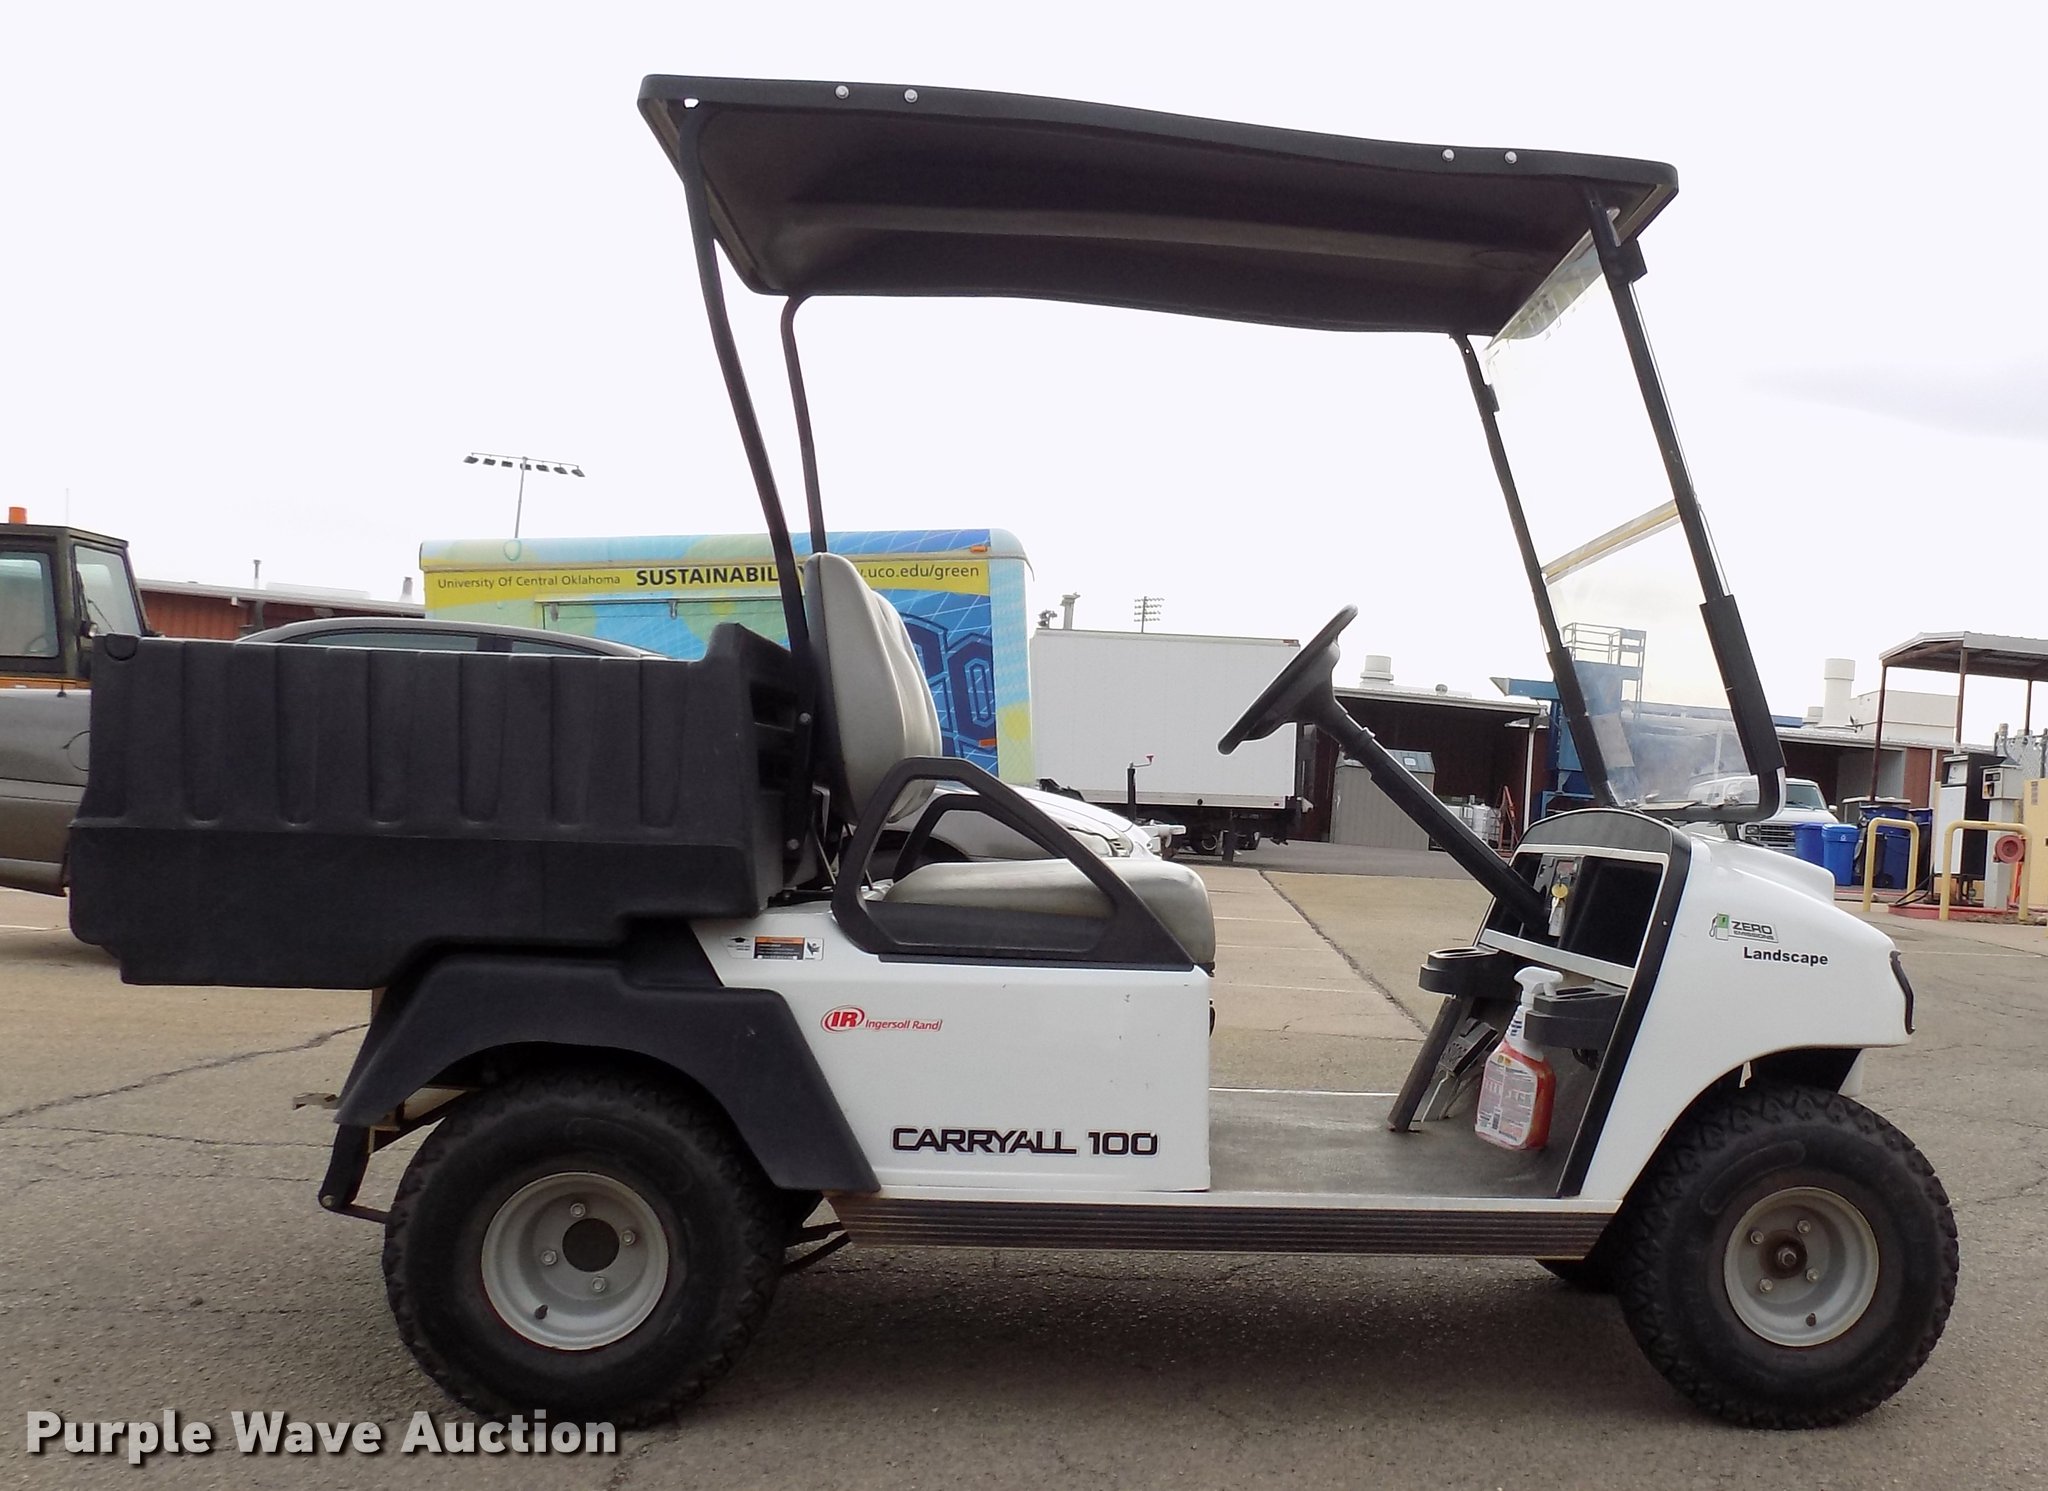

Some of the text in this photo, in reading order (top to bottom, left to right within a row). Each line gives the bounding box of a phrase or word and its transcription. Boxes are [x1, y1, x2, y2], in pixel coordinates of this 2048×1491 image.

[438, 574, 621, 589] University Of Central Oklahoma
[636, 566, 804, 586] SUSTAINABIL
[1731, 921, 1773, 935] ZERO
[1743, 946, 1829, 967] Landscape
[830, 1011, 859, 1028] IR
[865, 1019, 911, 1031] Ingersoll
[892, 1128, 1159, 1157] CARRYALL 100
